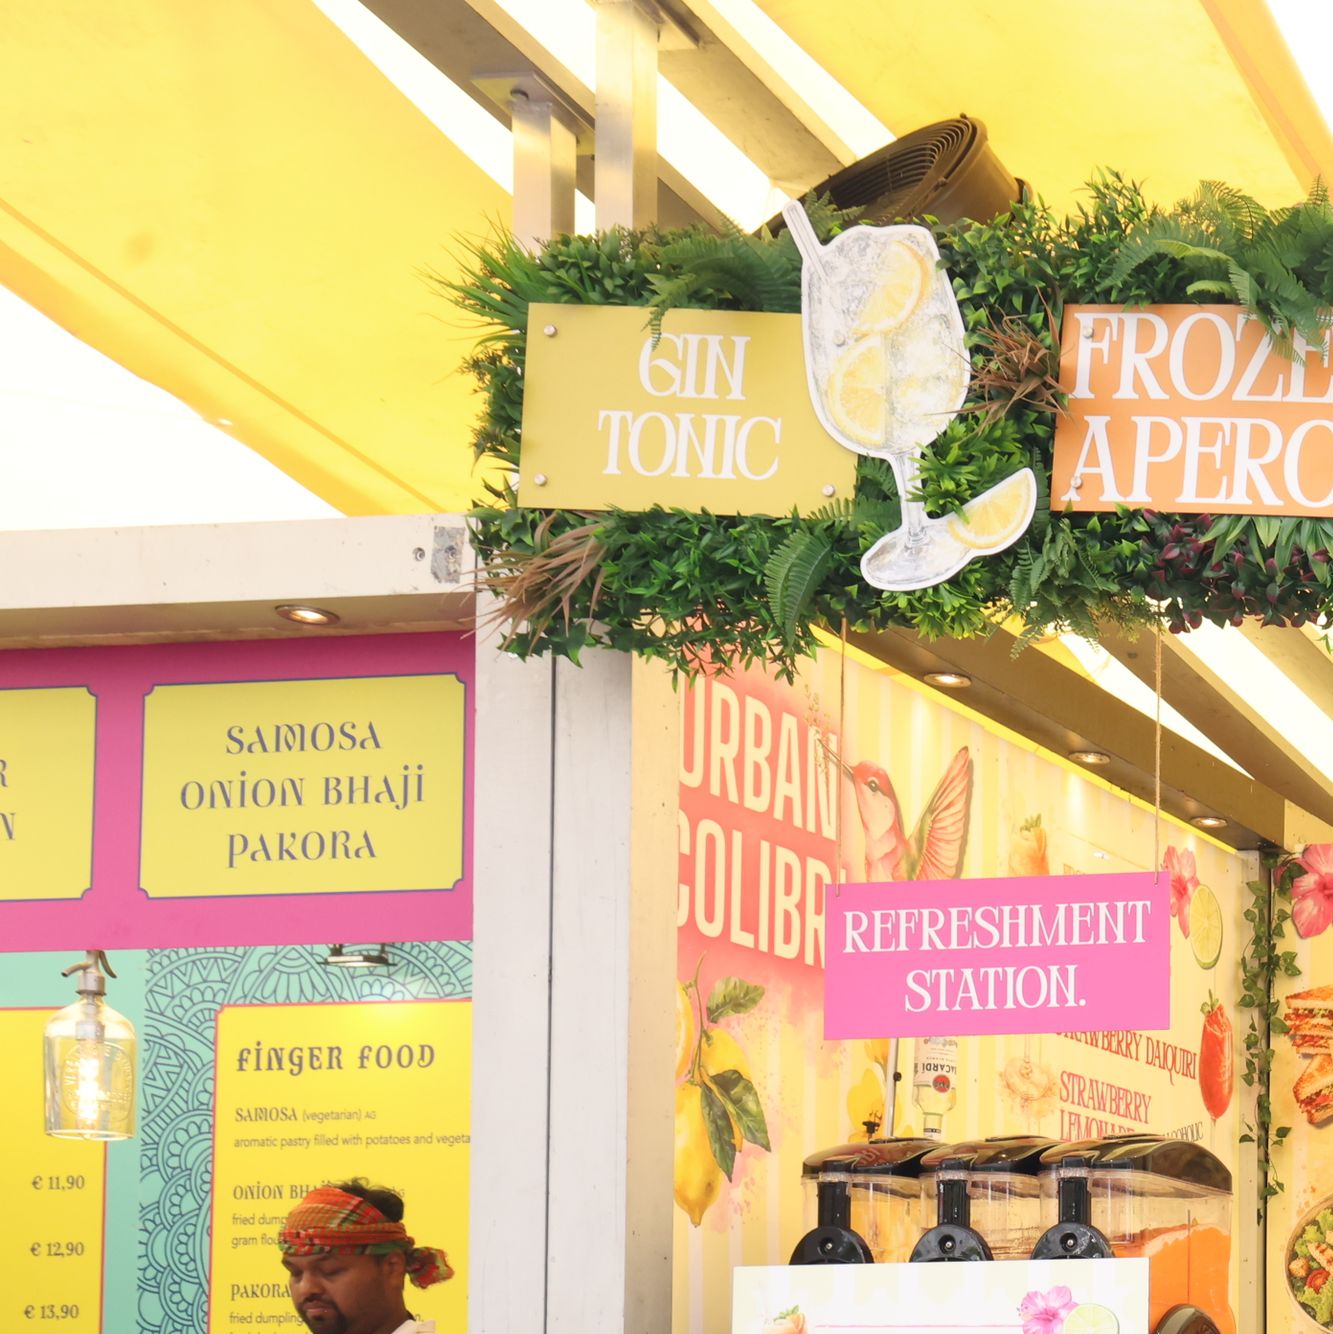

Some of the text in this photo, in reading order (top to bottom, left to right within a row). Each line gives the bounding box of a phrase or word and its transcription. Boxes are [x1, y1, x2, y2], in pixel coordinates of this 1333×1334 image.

[638, 333, 747, 400] GIN
[598, 411, 782, 480] TONIC
[225, 721, 382, 754] SAMOSA
[679, 673, 838, 842] URBAN
[227, 830, 377, 868] PAKORA
[677, 808, 846, 969] COLIBR
[842, 900, 1151, 954] REFRESHMENT
[904, 964, 1087, 1013] STATION.
[357, 1044, 436, 1070] FOOD
[1146, 1032, 1197, 1085] DAIQUIRI
[235, 1107, 298, 1122] SAMOSA
[1060, 1070, 1152, 1124] STRAWBERRY
[234, 1135, 277, 1148] aromatic
[281, 1136, 310, 1150] pastry
[342, 1134, 362, 1145] with
[366, 1134, 411, 1148] potatoes
[414, 1132, 433, 1144] and
[32, 1175, 85, 1191] € 11,90
[232, 1214, 255, 1225] fried
[31, 1241, 84, 1258] € 12,90
[24, 1305, 79, 1320] € 13,90
[230, 1313, 252, 1324] fried
